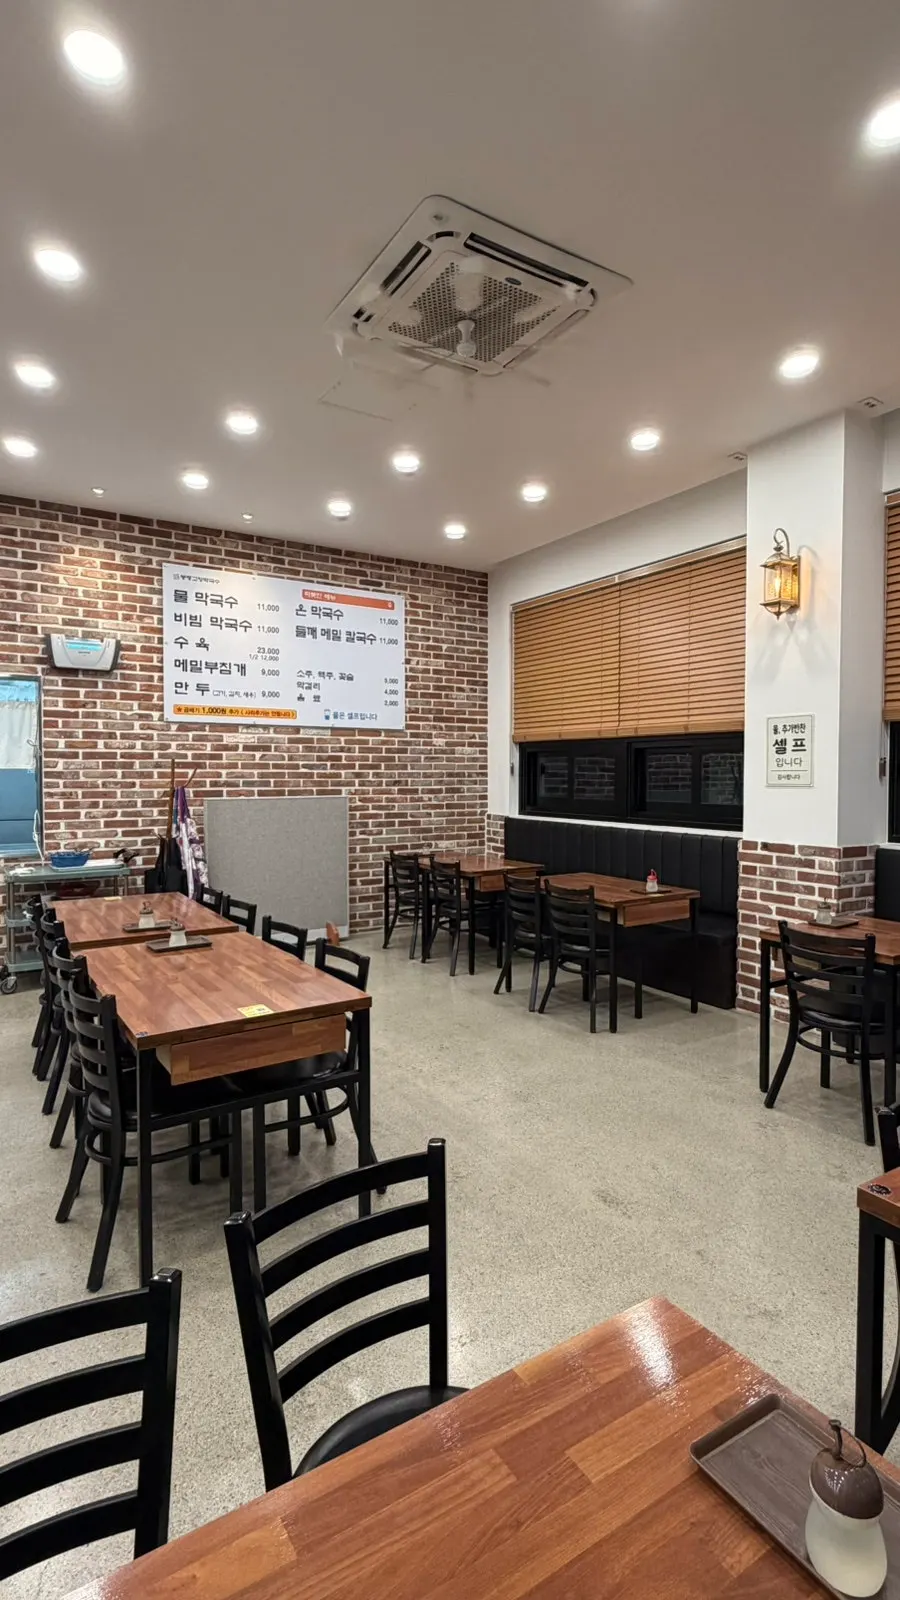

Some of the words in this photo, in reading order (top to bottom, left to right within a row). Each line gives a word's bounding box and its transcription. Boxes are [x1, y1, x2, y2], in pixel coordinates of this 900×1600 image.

[174, 589, 188, 603] 물
[195, 592, 238, 609] 막국수
[257, 604, 280, 612] 11,000
[174, 612, 202, 627] 비빔
[210, 616, 252, 632] 막국수
[257, 626, 280, 634] 11,000
[295, 604, 307, 617] 온
[311, 606, 344, 621] 막국수
[380, 618, 399, 626] 11,000
[295, 625, 317, 639] 들깨
[321, 628, 342, 642] 메밀
[346, 631, 376, 645] 칼국수
[380, 637, 398, 645] 11,000
[174, 658, 246, 676] 메밀부침개
[261, 669, 280, 677] 9,000
[296, 681, 320, 691] 막걸리
[782, 723, 806, 734] 추가반찬
[776, 757, 802, 768] 입니다
